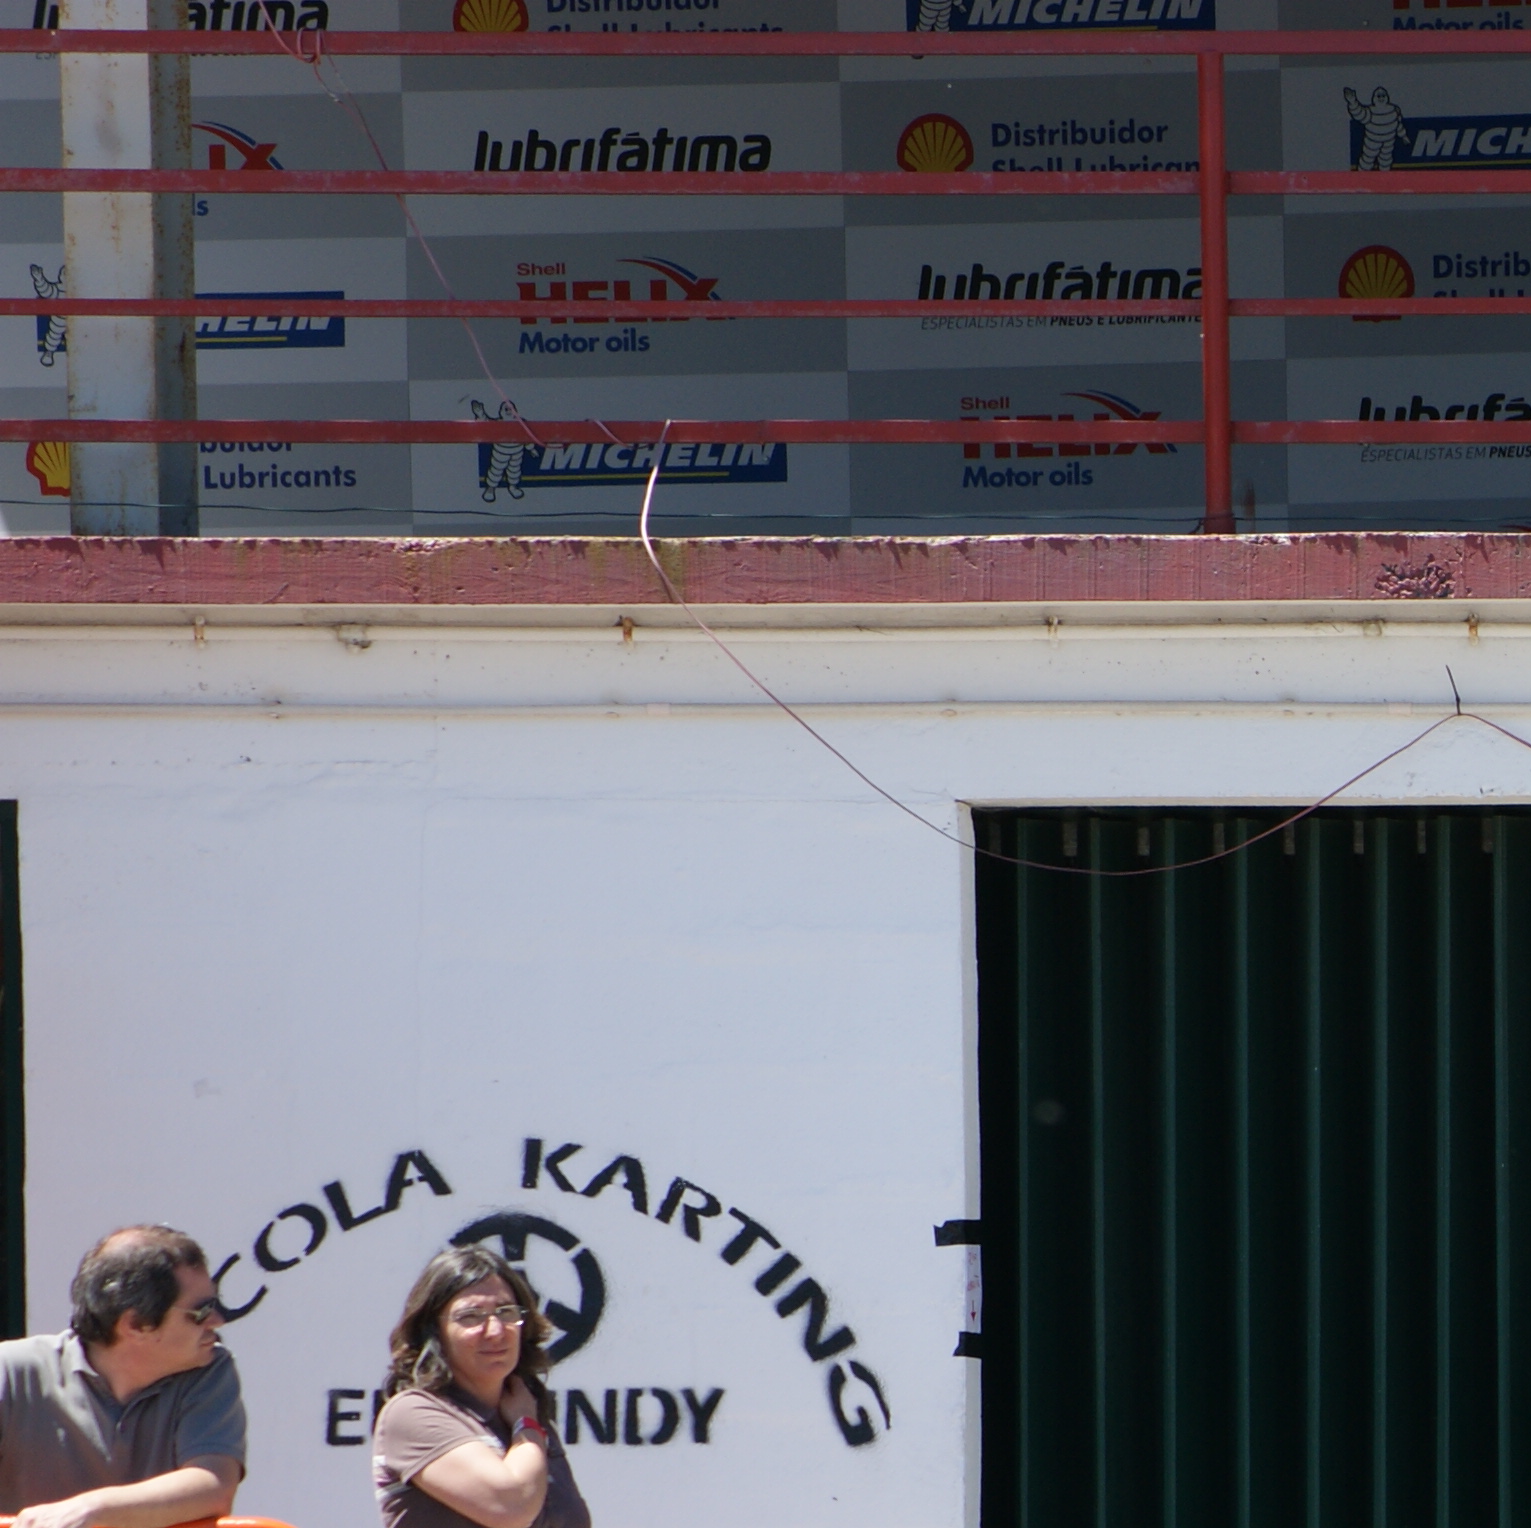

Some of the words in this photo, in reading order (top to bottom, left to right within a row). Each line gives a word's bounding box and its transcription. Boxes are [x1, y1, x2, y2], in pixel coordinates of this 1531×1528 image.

[966, 0, 1205, 26] MICHELIN
[991, 118, 1169, 148] Distribuidor
[516, 262, 566, 277] Shell
[918, 261, 1202, 301] lubrifátim
[518, 330, 600, 355] Motor
[605, 327, 651, 354] oils
[960, 396, 1011, 411] Shell
[539, 443, 776, 470] MICHELIN
[1360, 446, 1463, 463] ESPECIALISTAS
[1465, 446, 1488, 460] EM
[203, 463, 357, 490] Lubricants
[962, 466, 1044, 489] Motor
[1048, 462, 1094, 487] oils
[212, 1149, 452, 1323] COLA
[521, 1137, 892, 1447] KARTING
